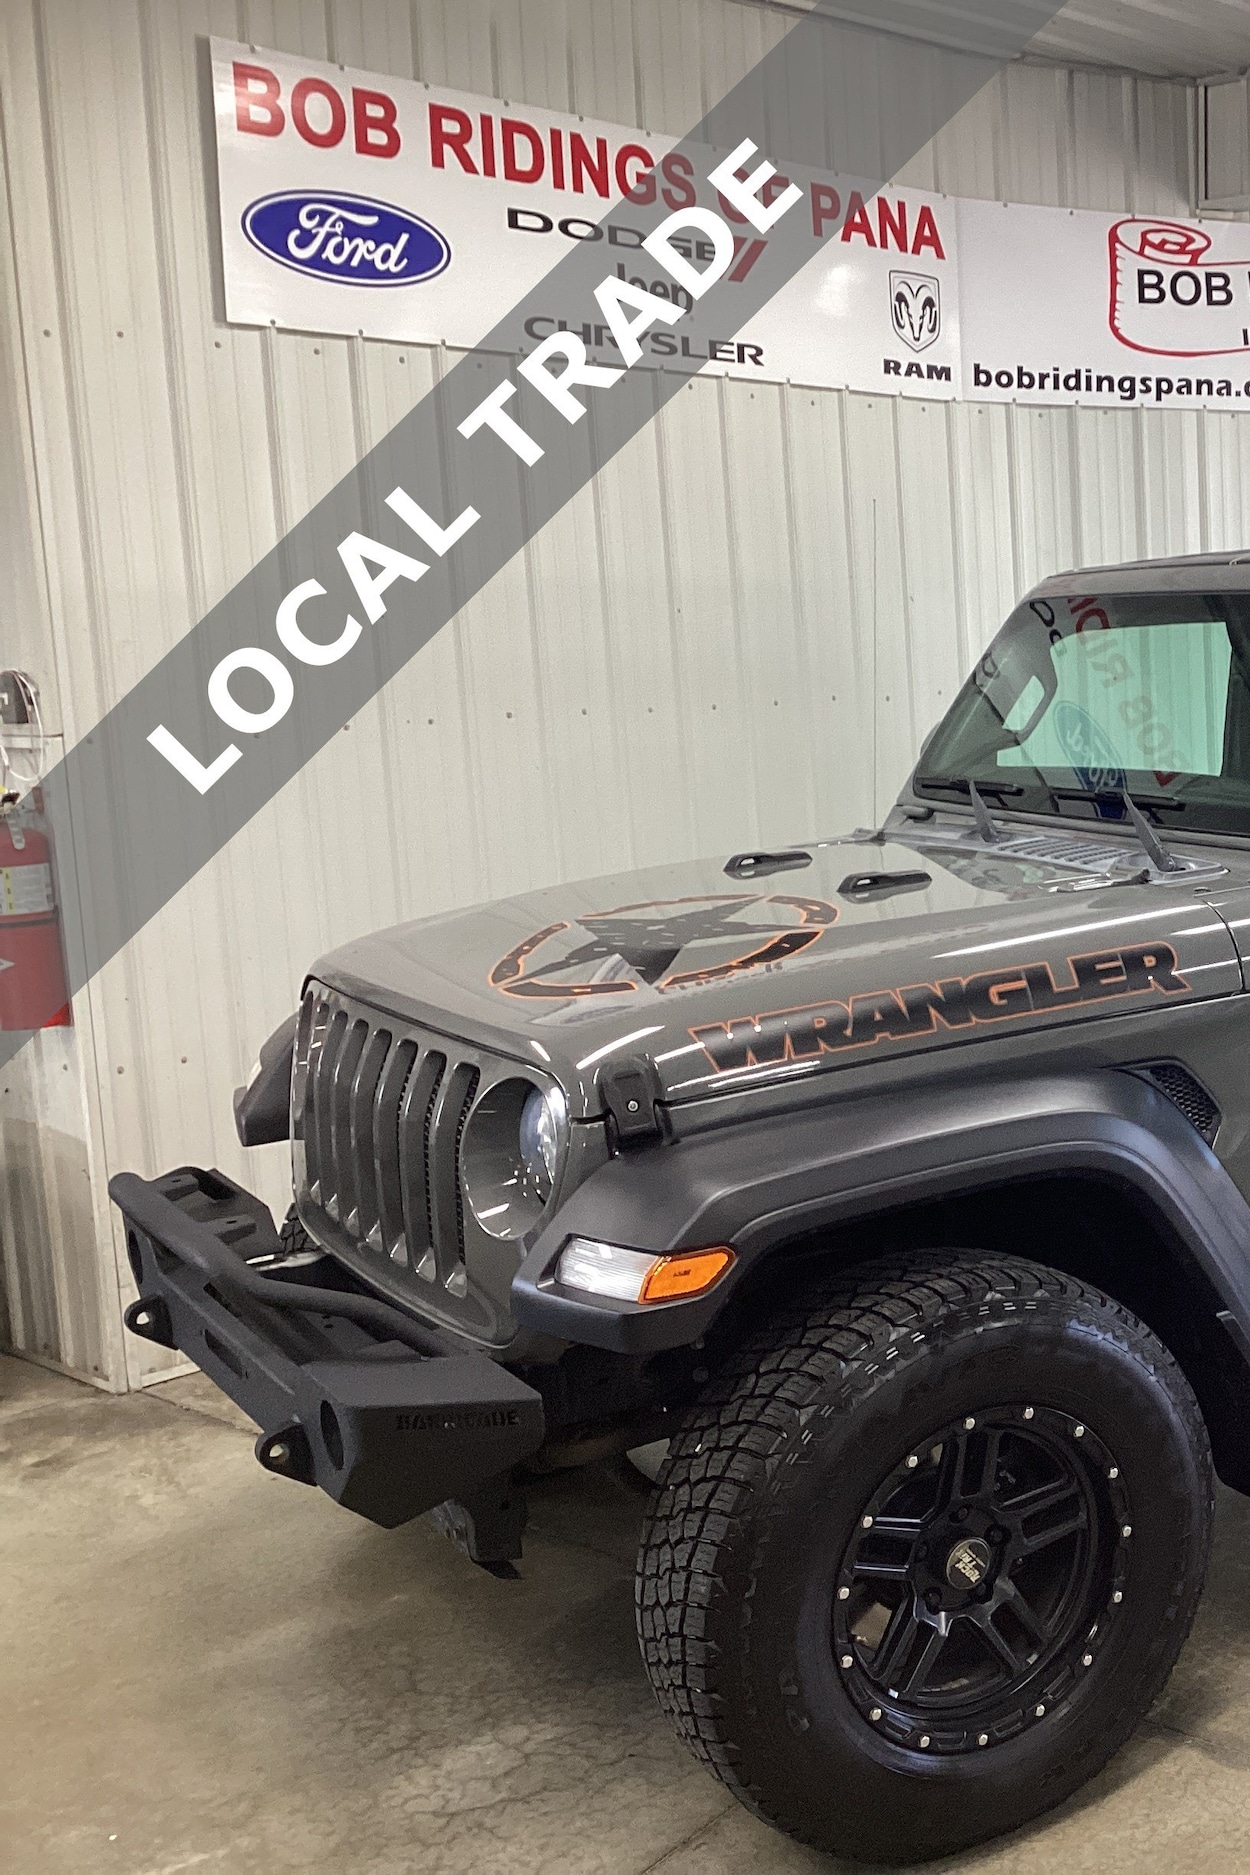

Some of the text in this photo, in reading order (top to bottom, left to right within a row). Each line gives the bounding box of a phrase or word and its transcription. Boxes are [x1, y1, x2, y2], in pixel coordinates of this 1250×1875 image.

[232, 60, 401, 159] BOB
[428, 101, 697, 213] RIDINGS
[810, 181, 946, 260] PANA
[286, 203, 410, 274] Ford
[1137, 269, 1233, 306] BOB
[883, 358, 952, 382] RAM
[687, 941, 1192, 1073] WRANGLER
